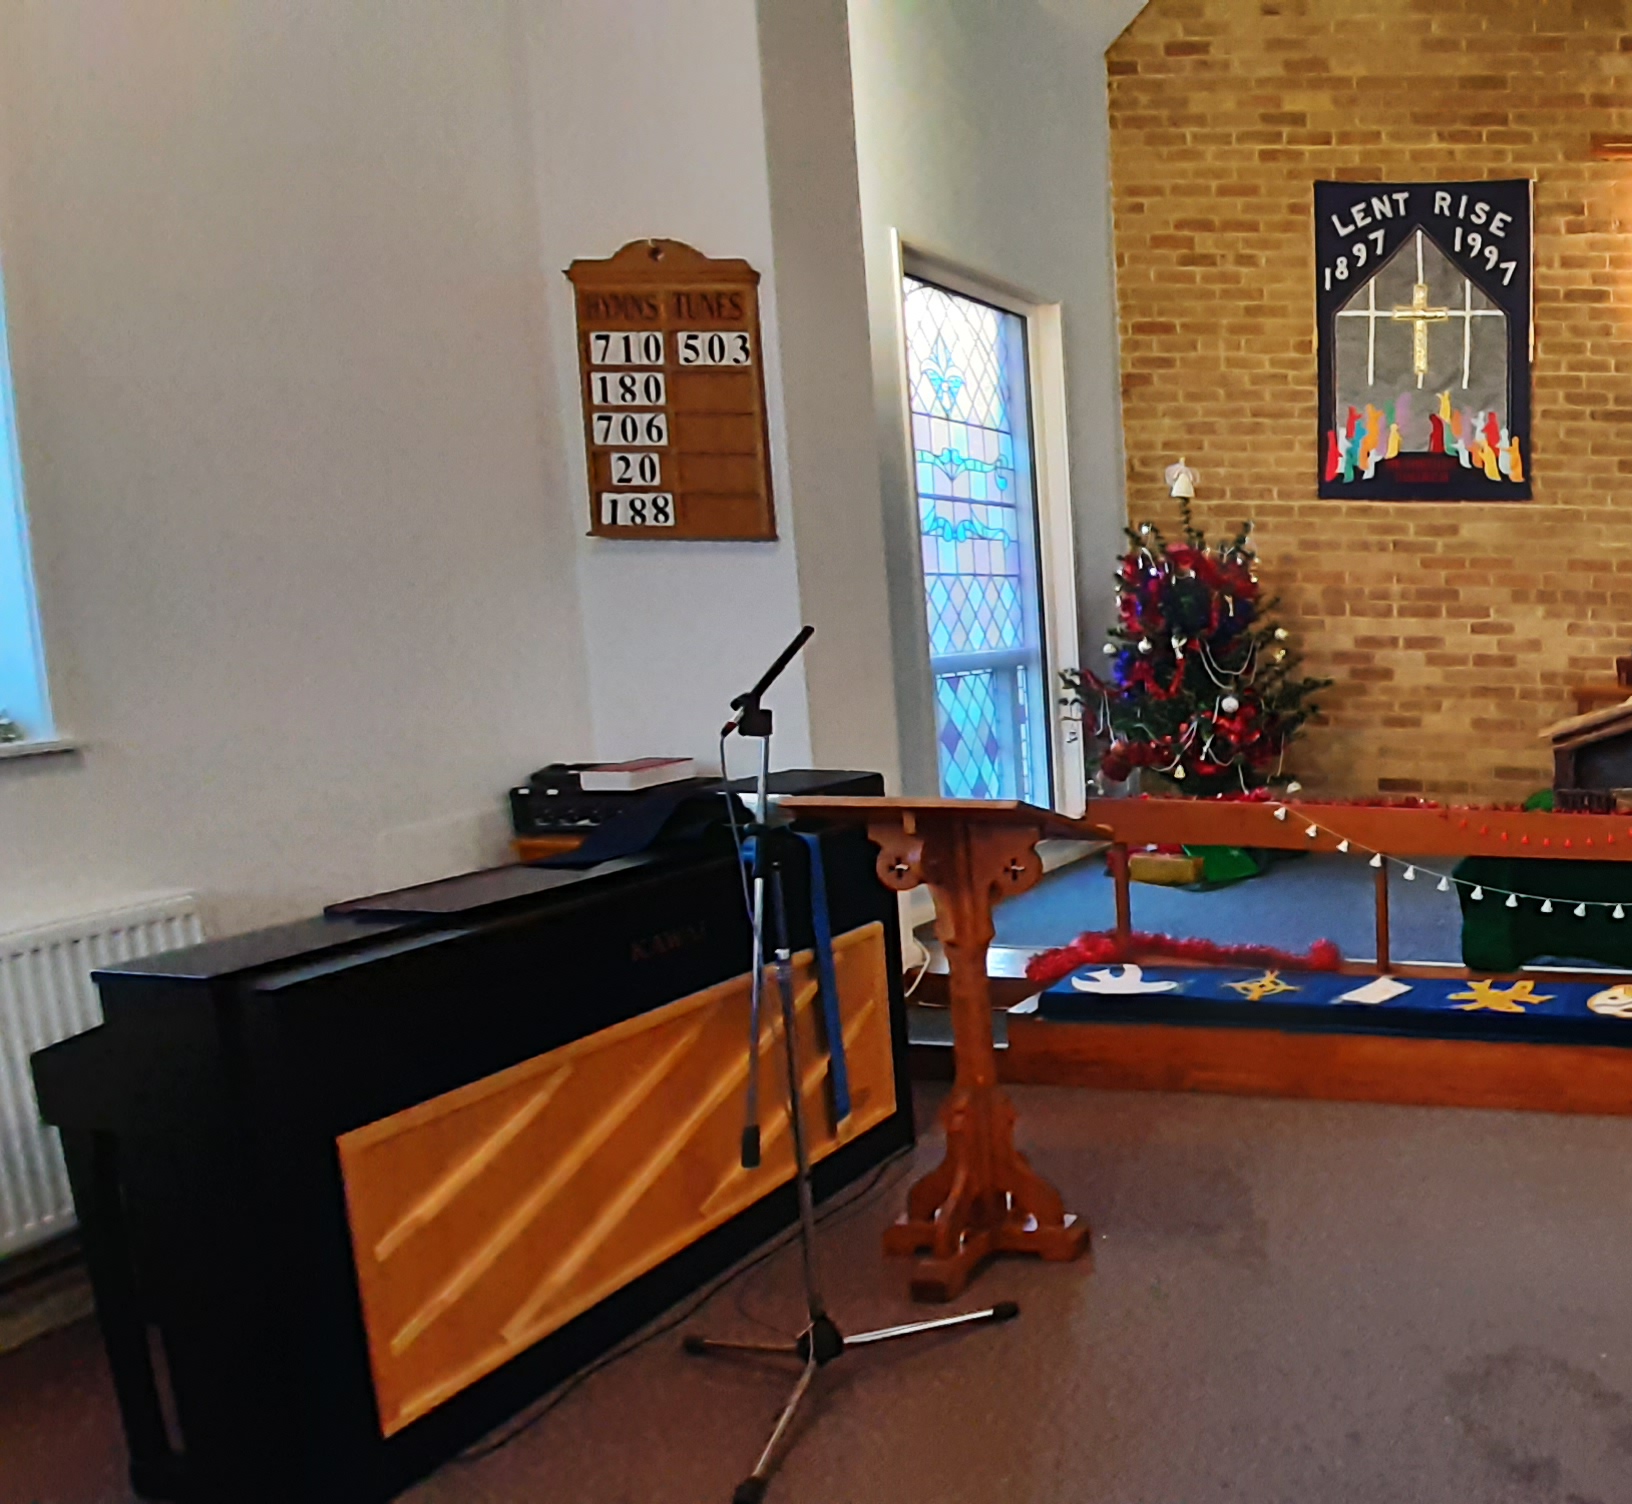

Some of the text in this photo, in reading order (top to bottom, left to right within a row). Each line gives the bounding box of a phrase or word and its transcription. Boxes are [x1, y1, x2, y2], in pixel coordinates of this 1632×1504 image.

[1331, 190, 1513, 238] LENT RISE
[1324, 228, 1386, 291] 1897
[1454, 226, 1517, 286] 1997
[672, 291, 744, 320] TUNES
[594, 333, 662, 363] 710
[683, 333, 750, 364] 503
[597, 374, 662, 404] 180
[596, 414, 664, 443] 706
[616, 454, 657, 484] 20
[608, 495, 670, 525] 188
